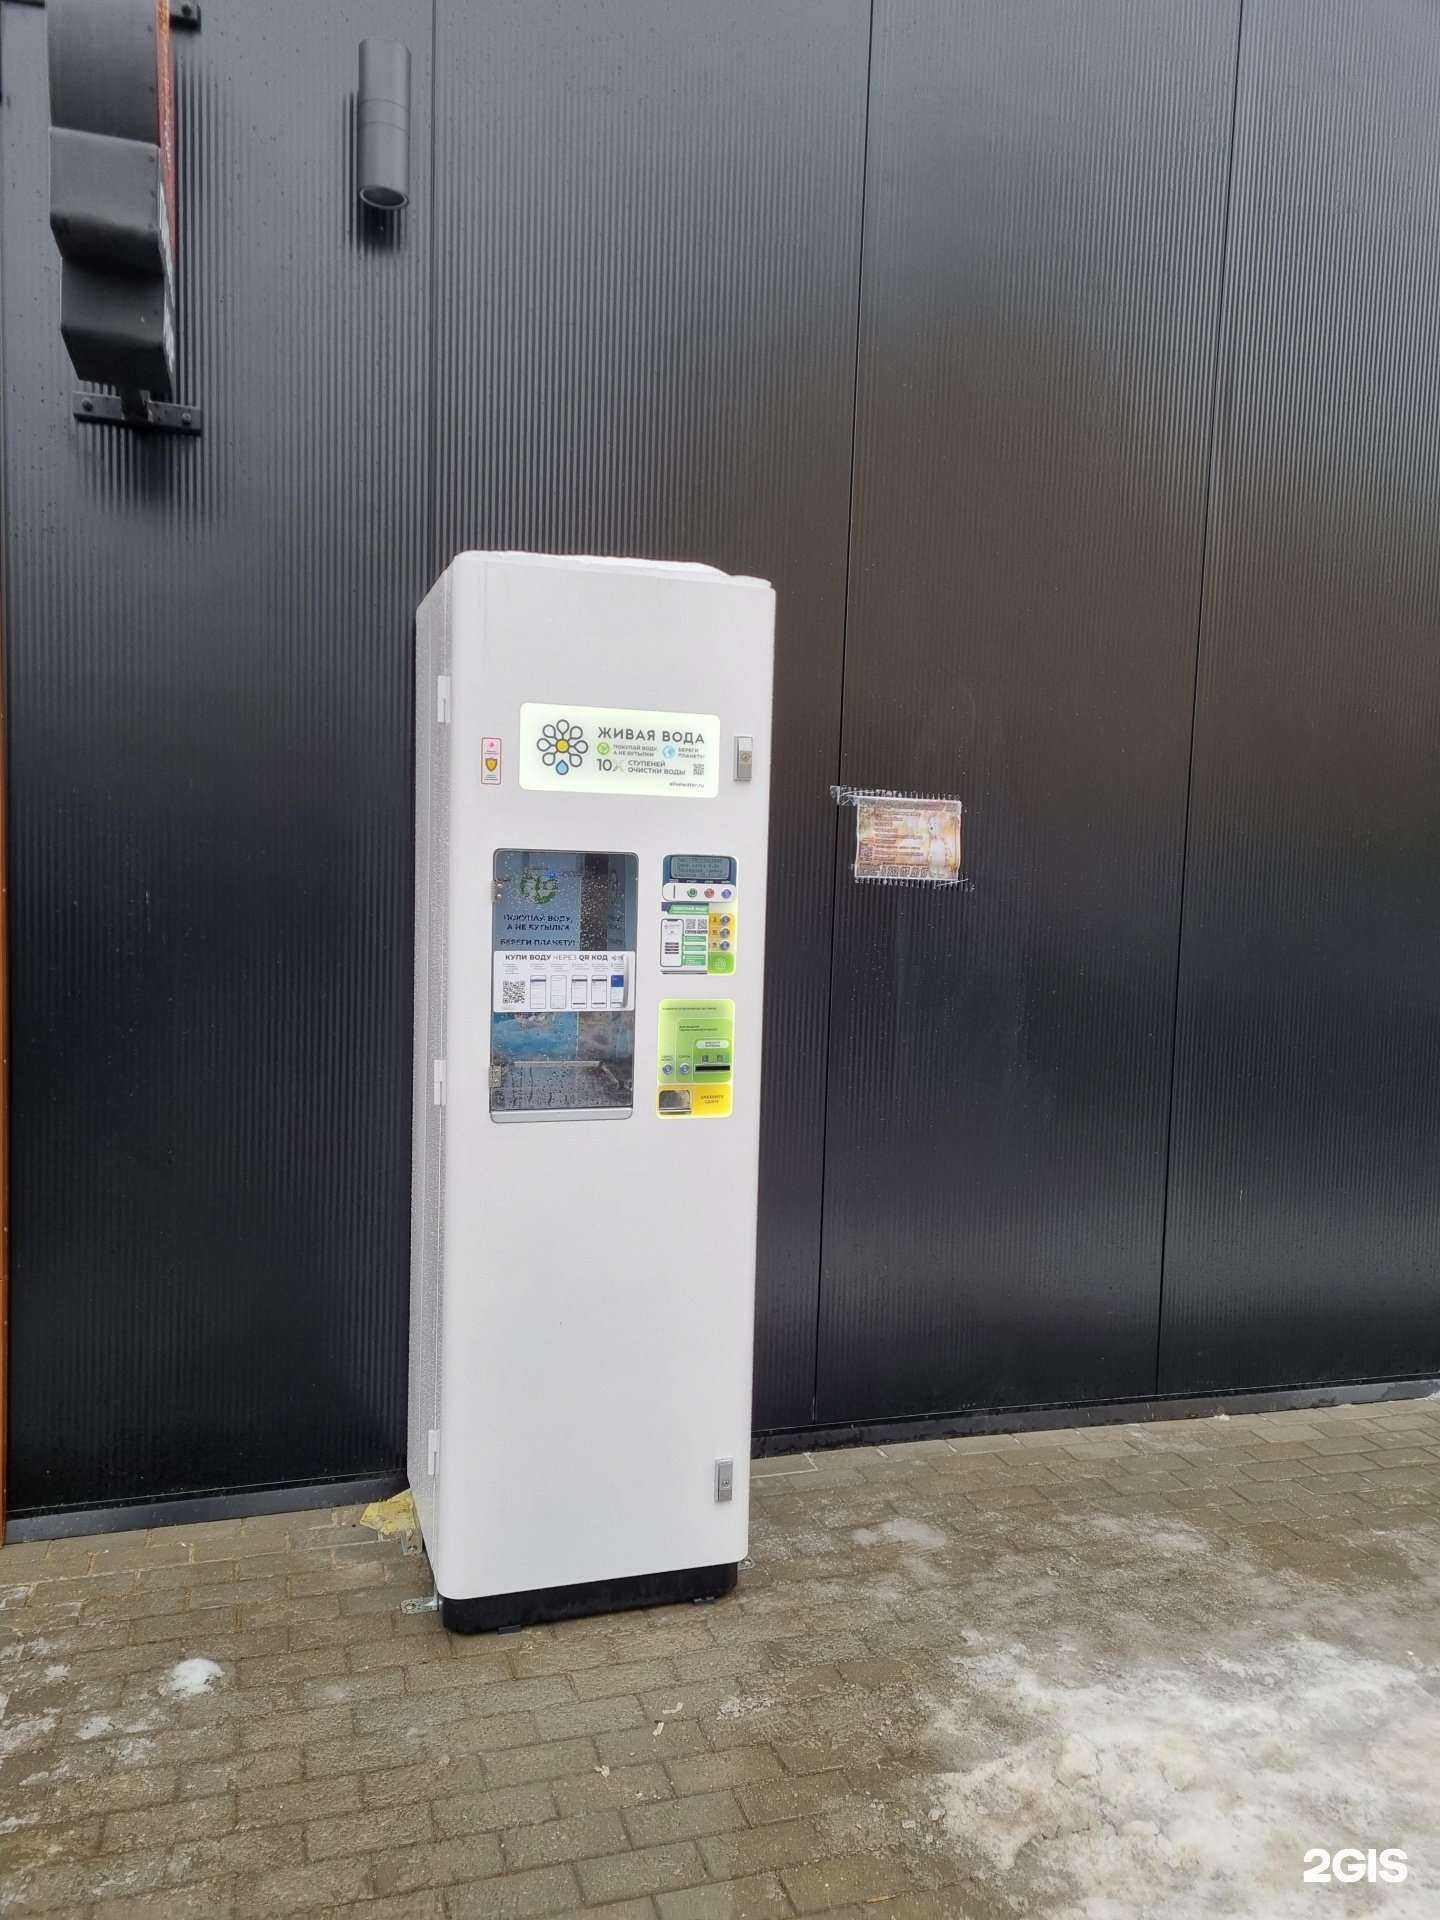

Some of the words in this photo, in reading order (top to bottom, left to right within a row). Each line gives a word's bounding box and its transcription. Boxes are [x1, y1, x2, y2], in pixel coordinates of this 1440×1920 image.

[598, 727, 656, 741] ЖИВАЯ
[662, 730, 705, 745] ВОДА
[628, 759, 666, 768] СТУПЕНЕЙ
[628, 766, 662, 775] ОЧИСТКИ
[663, 768, 686, 776] ВОДЫ
[507, 923, 513, 931] А
[515, 923, 527, 931] НЕ
[500, 938, 532, 947] БЕРЕГИ
[529, 954, 552, 962] ВОДУ
[591, 954, 608, 962] КОД
